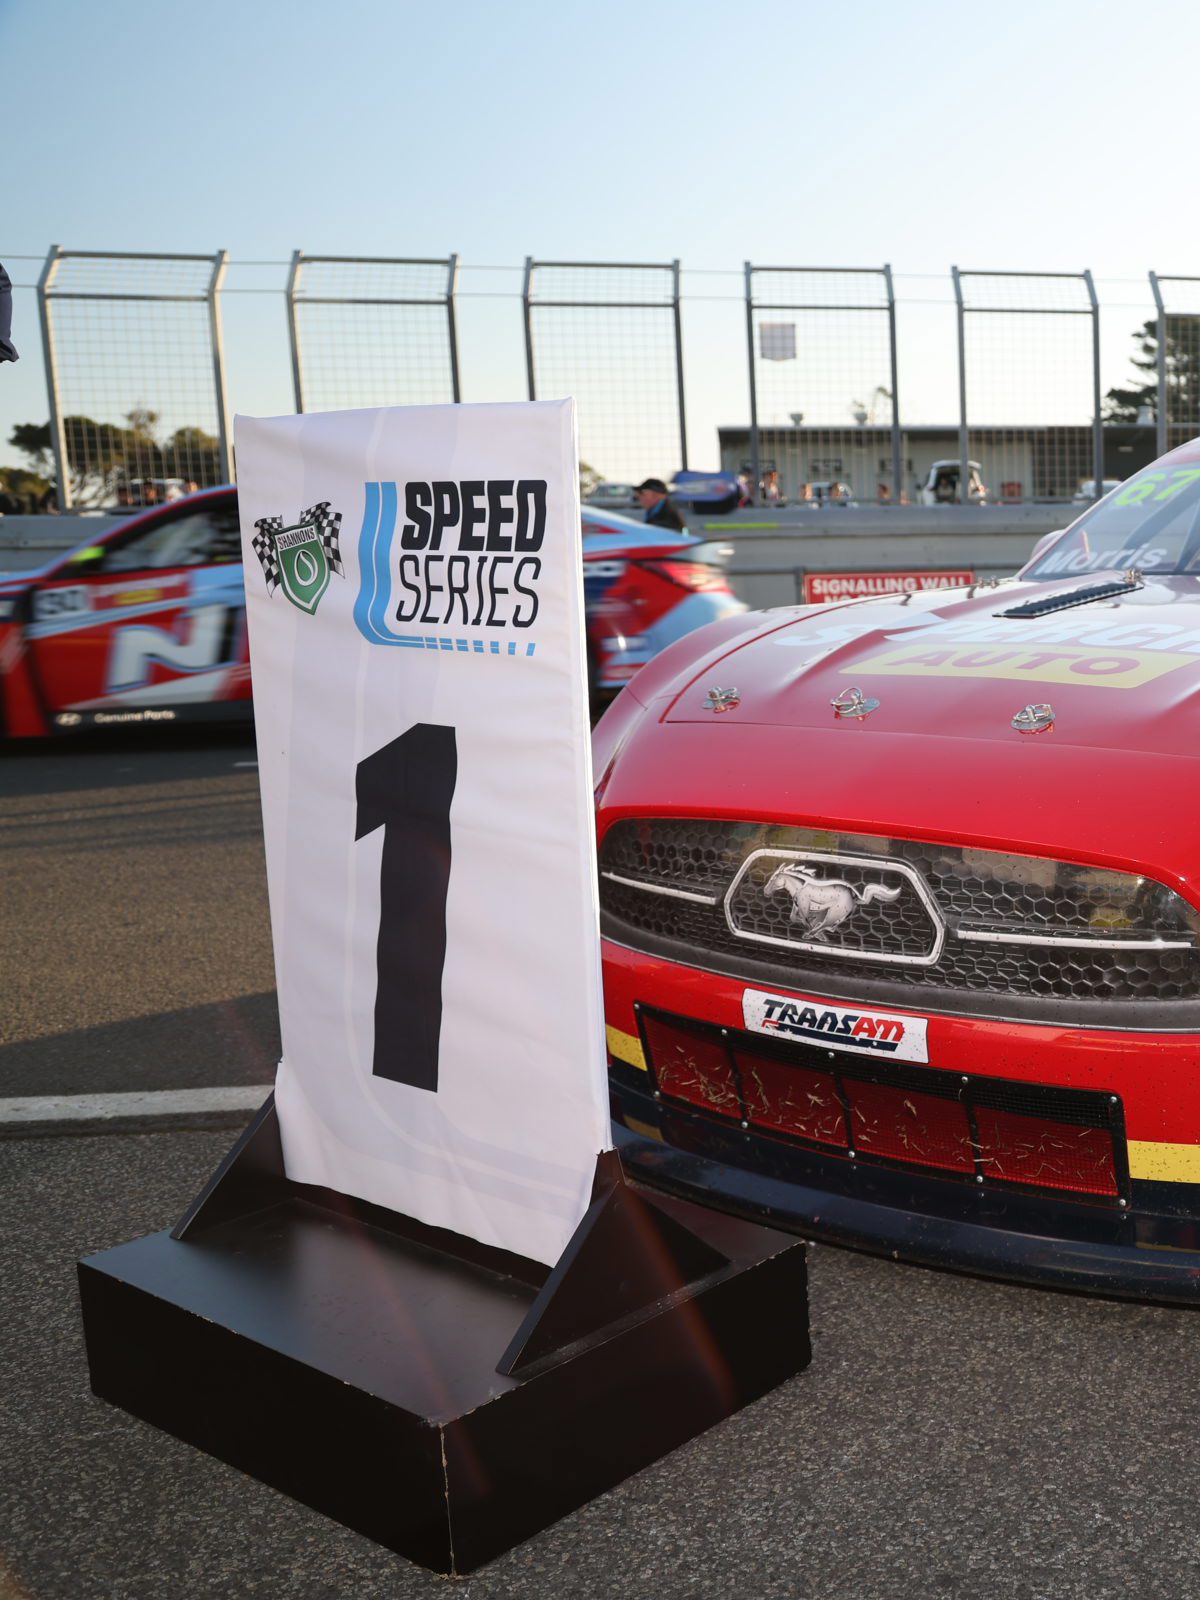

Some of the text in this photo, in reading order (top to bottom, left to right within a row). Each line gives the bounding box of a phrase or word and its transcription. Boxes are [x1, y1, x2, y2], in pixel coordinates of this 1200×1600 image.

[401, 479, 547, 552] SPEED
[277, 526, 316, 550] SHANNONS
[1034, 543, 1168, 576] Morris
[396, 554, 542, 629] SERIES
[811, 575, 965, 595] SIGNALLING WALL
[885, 648, 1140, 676] AUTO
[354, 723, 458, 1093] 1
